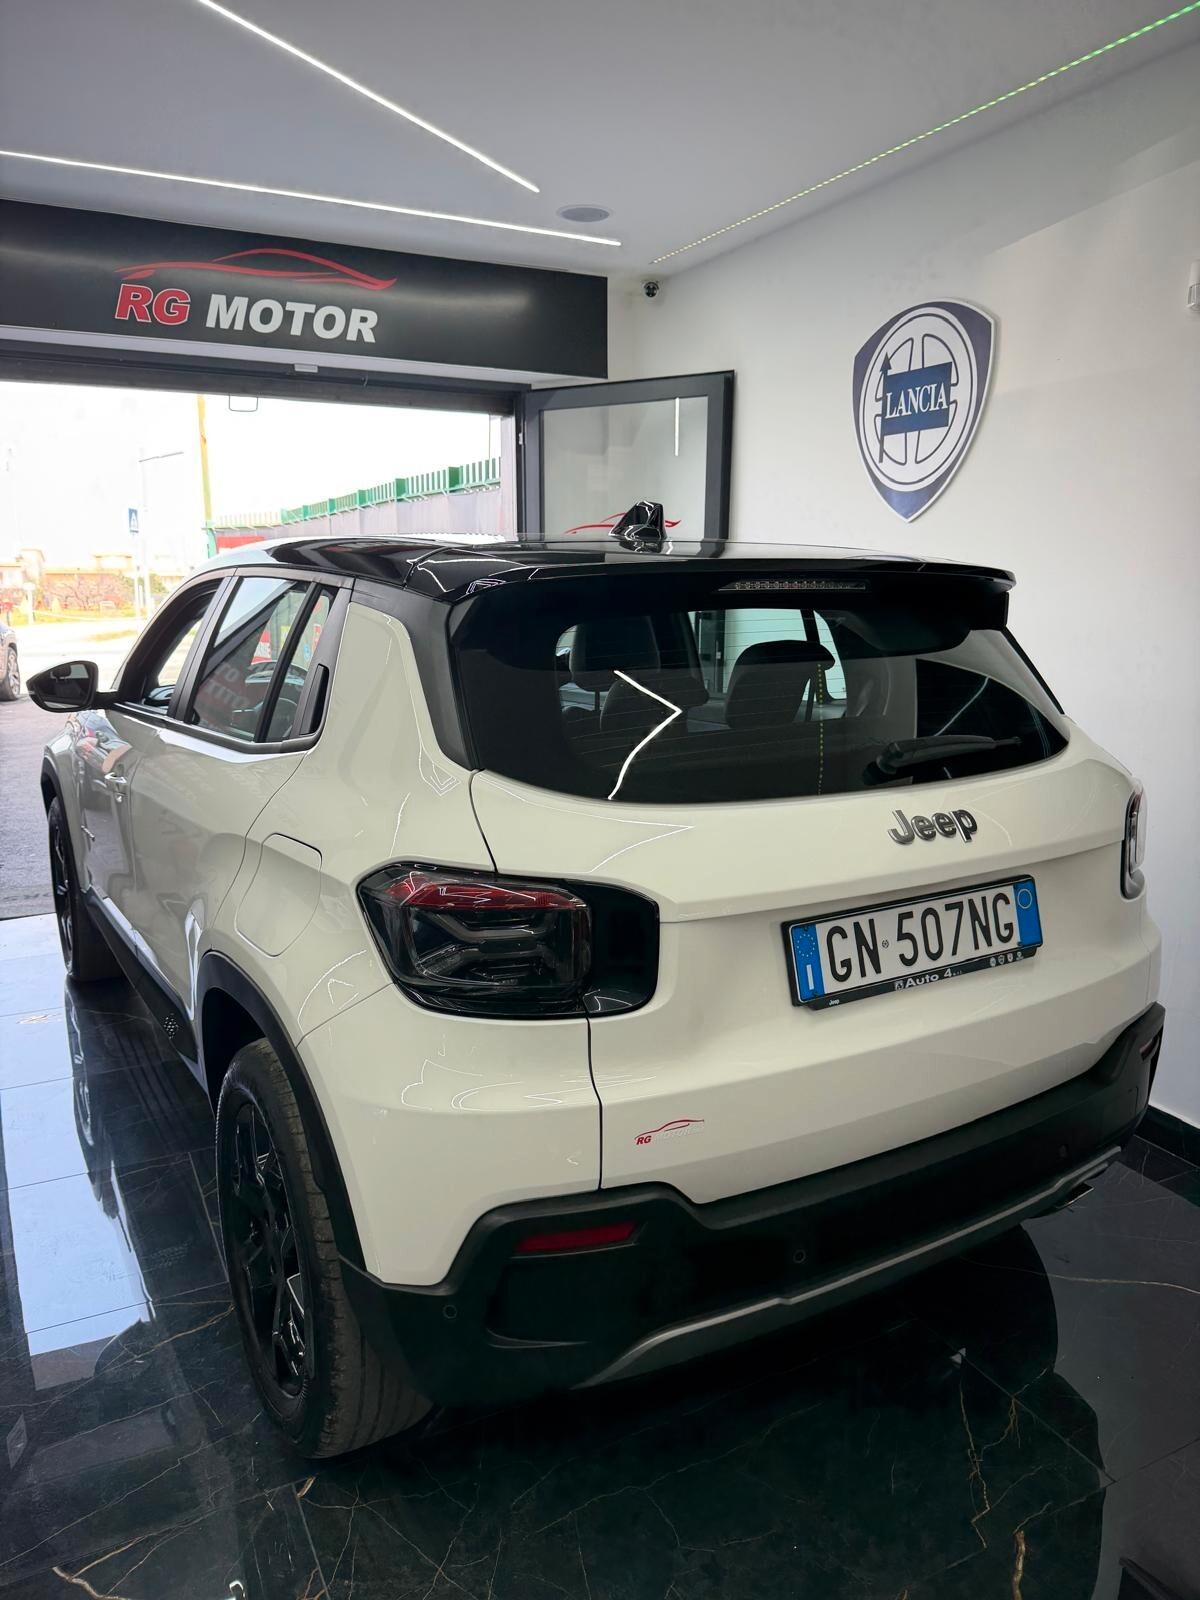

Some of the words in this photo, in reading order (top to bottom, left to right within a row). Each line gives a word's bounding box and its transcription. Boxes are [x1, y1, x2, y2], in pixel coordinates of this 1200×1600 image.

[115, 284, 191, 326] RG
[205, 293, 379, 343] MOTOR
[885, 382, 949, 419] LANCIA
[887, 809, 978, 845] Jeep
[826, 918, 882, 982] GN
[896, 892, 1014, 967] 507NG
[905, 974, 939, 988] Auto
[944, 968, 952, 978] 4
[636, 1135, 652, 1145] RG
